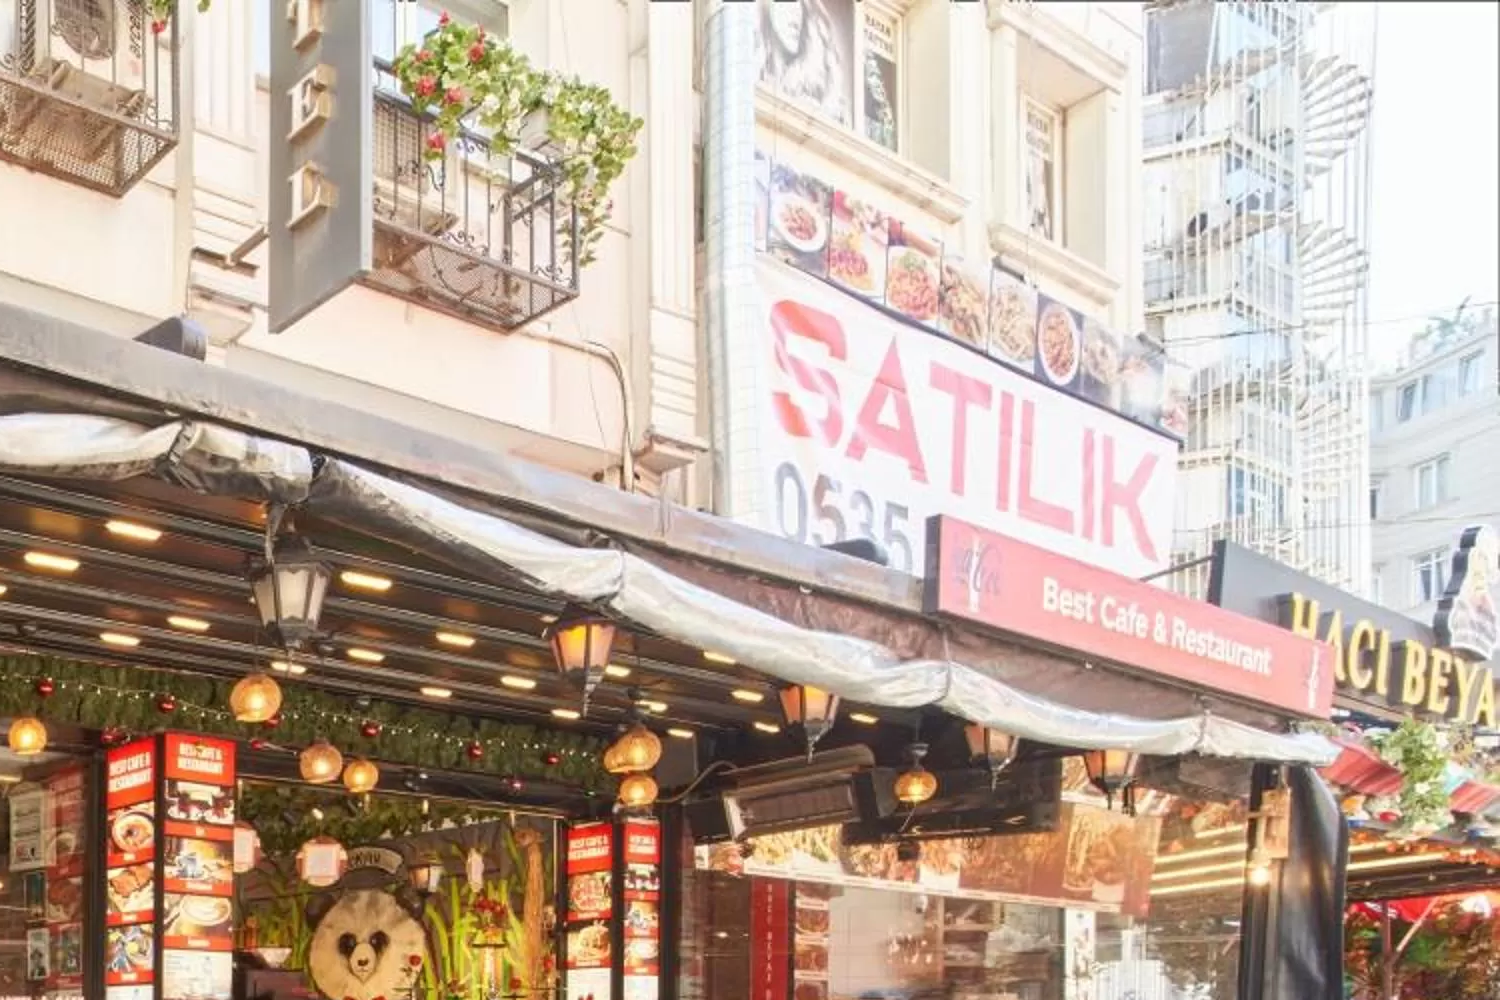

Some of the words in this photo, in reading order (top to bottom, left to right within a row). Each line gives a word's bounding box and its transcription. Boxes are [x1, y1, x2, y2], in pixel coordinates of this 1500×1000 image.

[769, 299, 1160, 562] SATILIK
[775, 461, 913, 573] 0535
[1042, 576, 1093, 625] Best
[1100, 595, 1147, 638] Cafe
[1153, 612, 1168, 645] &
[1171, 615, 1273, 675] Restaurant
